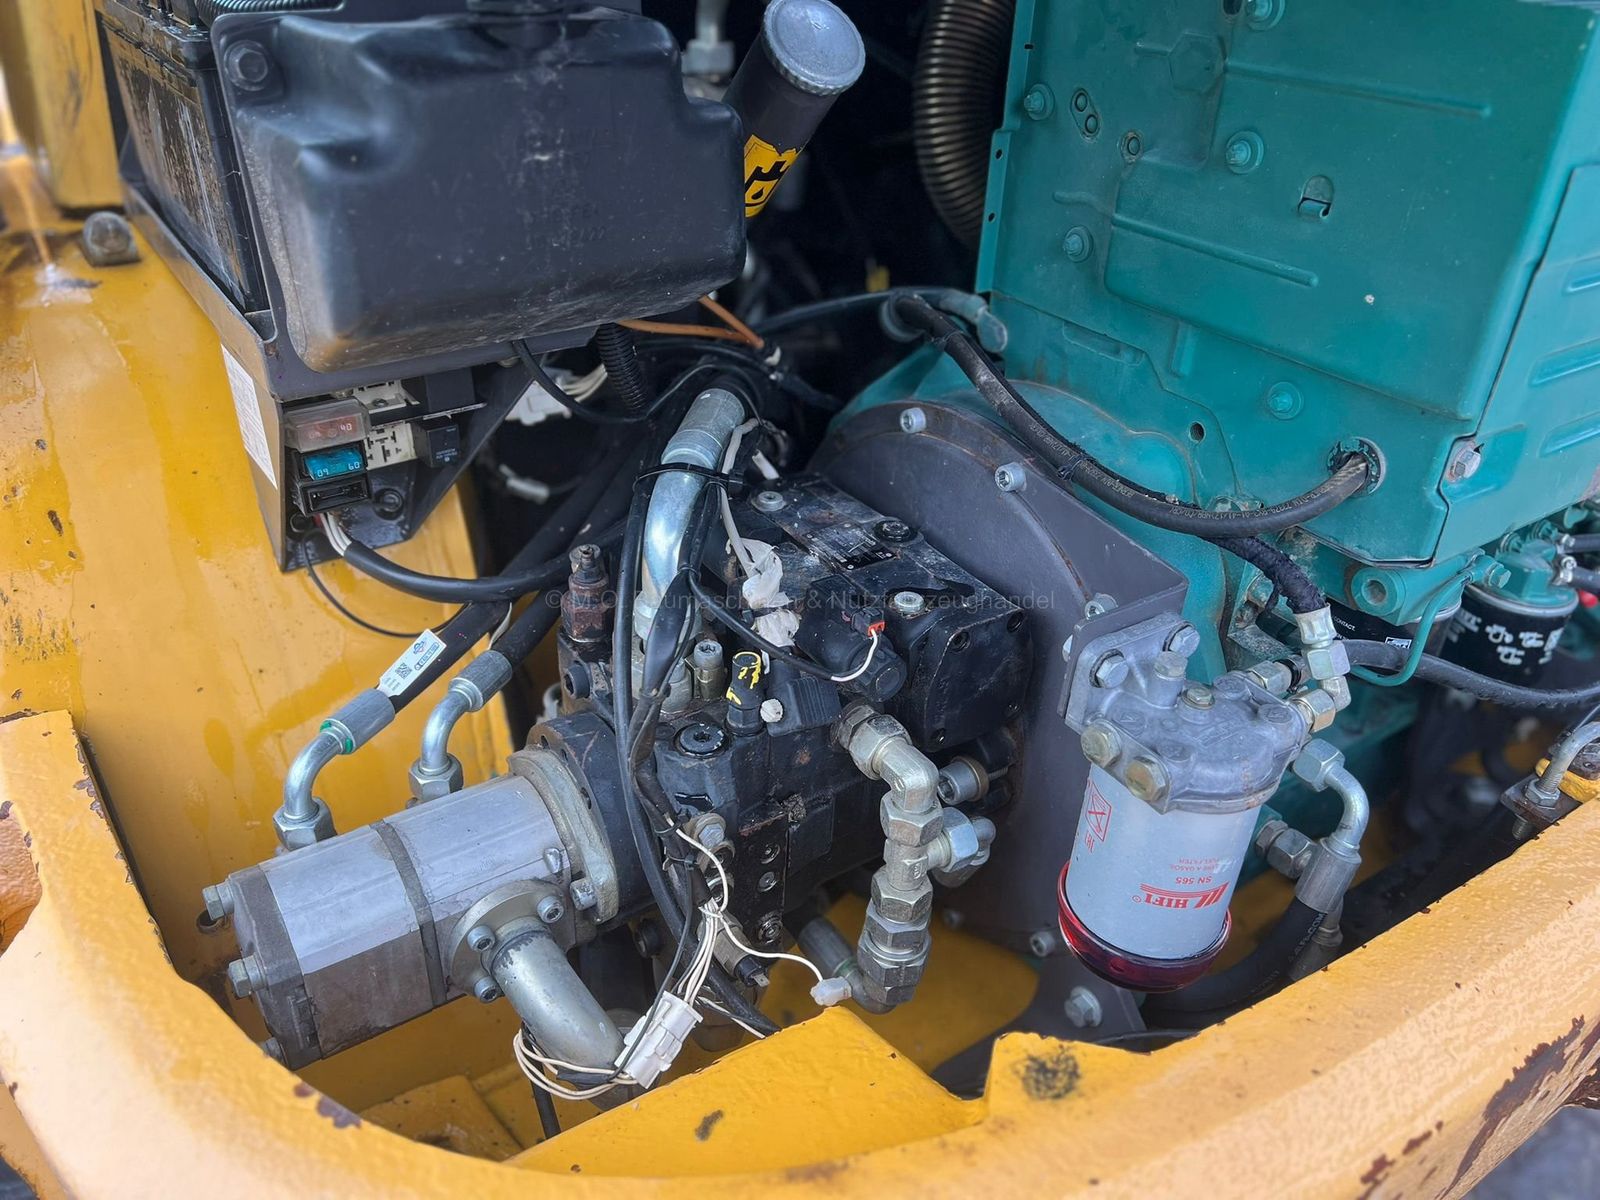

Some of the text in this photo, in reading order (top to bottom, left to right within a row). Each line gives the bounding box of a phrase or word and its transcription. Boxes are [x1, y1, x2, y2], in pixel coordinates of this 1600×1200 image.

[340, 423, 352, 431] 40
[348, 461, 360, 470] 60
[1175, 876, 1212, 885] SN 565
[1145, 893, 1188, 909] HIFI
